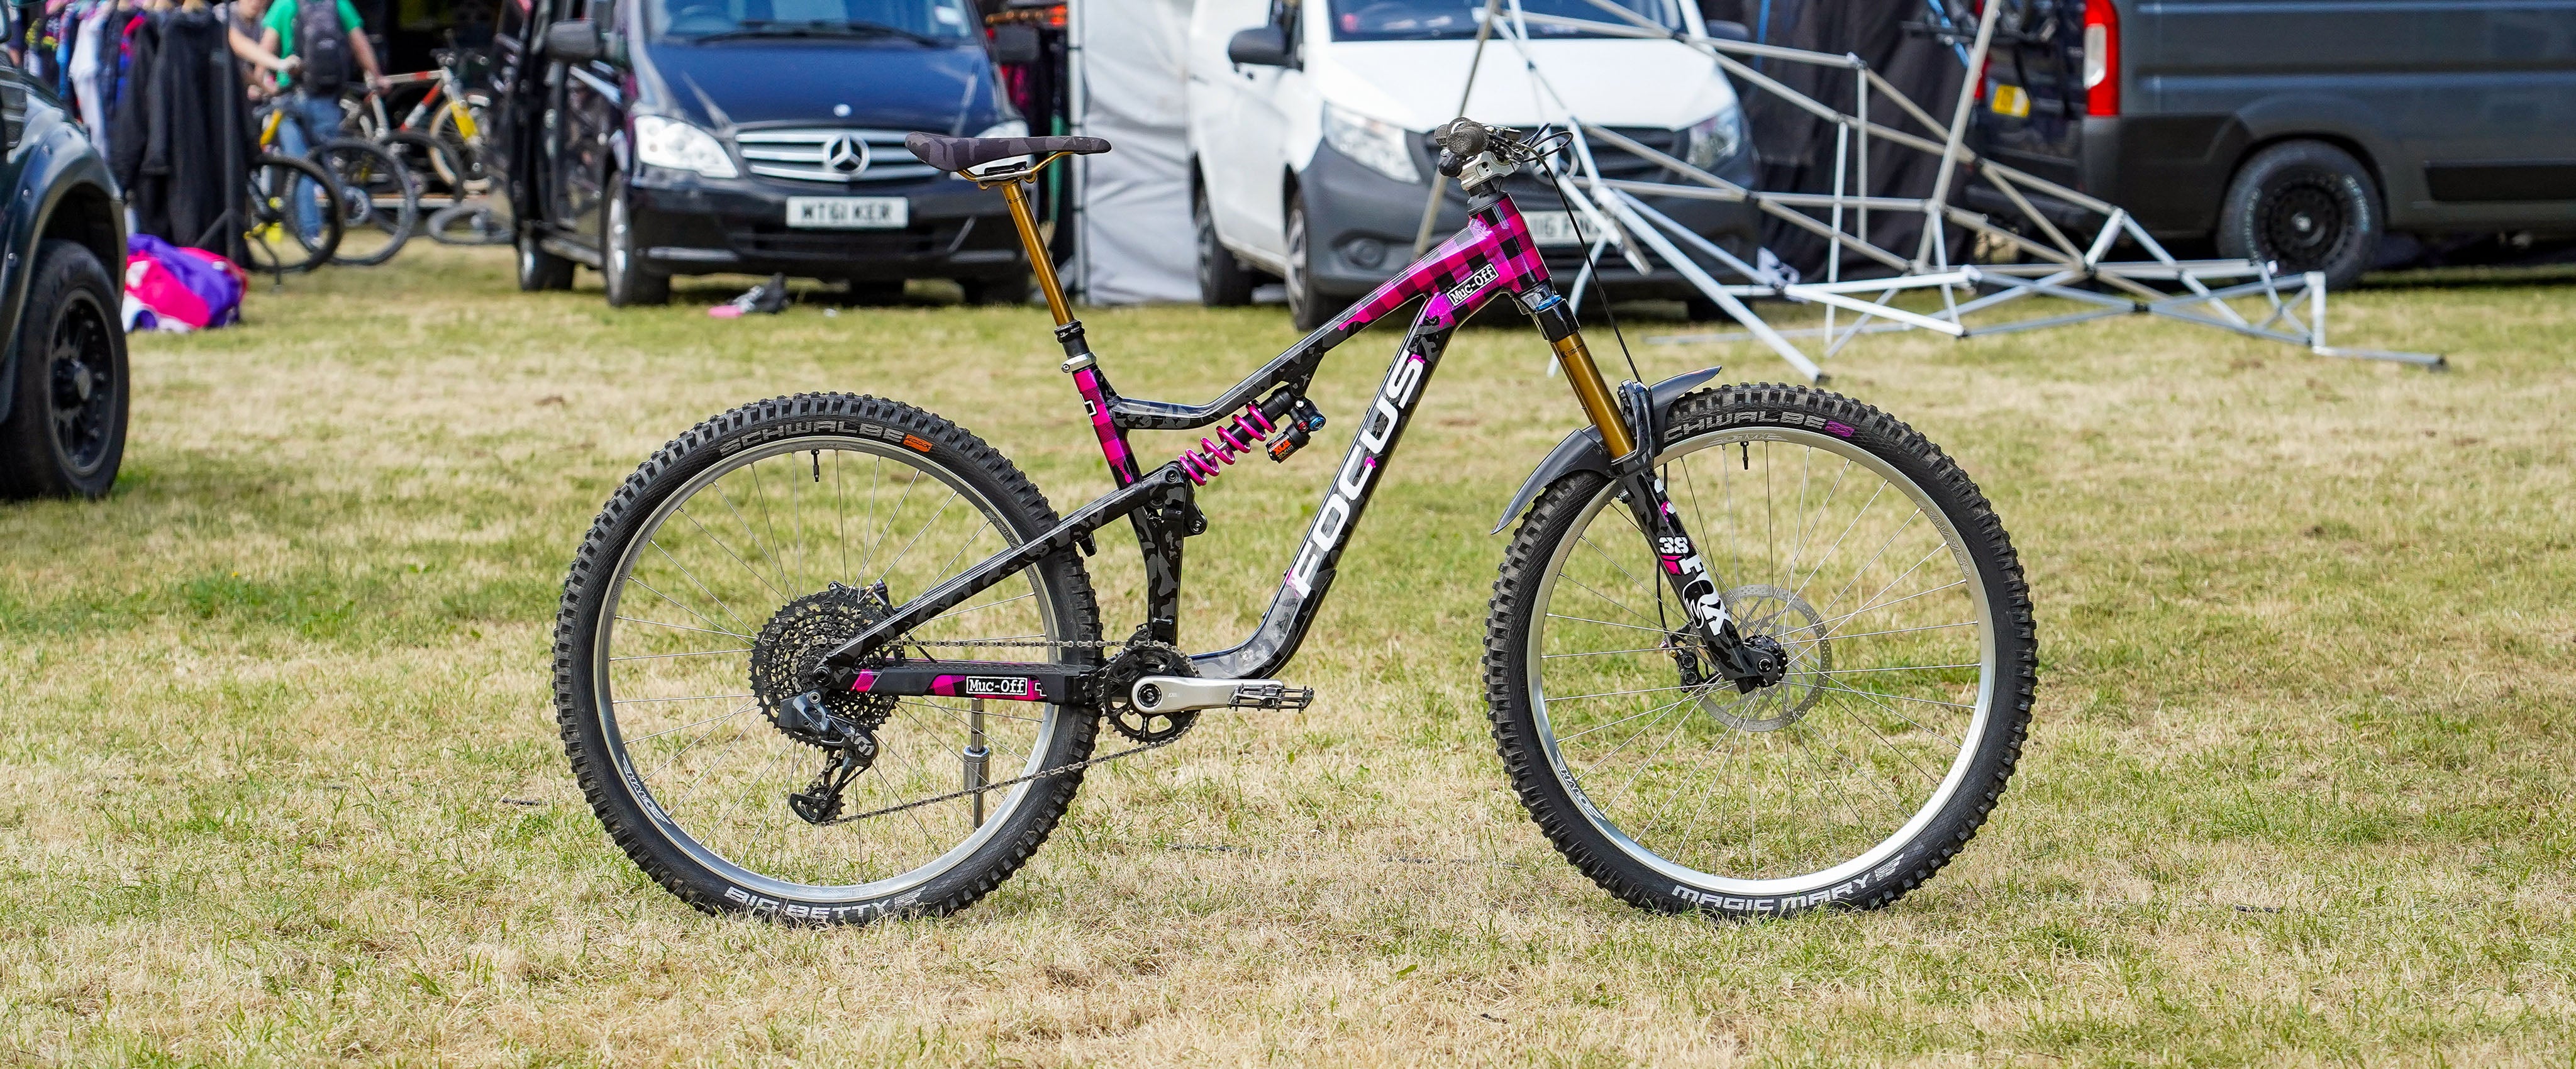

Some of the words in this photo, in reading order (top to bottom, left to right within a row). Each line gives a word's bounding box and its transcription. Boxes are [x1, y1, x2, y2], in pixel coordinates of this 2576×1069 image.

[1450, 265, 1496, 303] Muc-Off
[719, 421, 904, 456] SCHWALBE
[1664, 411, 1826, 443] CHWALBE
[1272, 439, 1292, 456] FOX
[1286, 349, 1425, 599] FOCUS
[1915, 497, 1972, 576] GRAVITAS
[1678, 553, 1733, 636] FOX
[969, 679, 1025, 693] Muc-Off
[724, 886, 780, 912] BIG
[787, 899, 890, 919] BETTY
[1672, 884, 1774, 911] MAGIC
[1780, 873, 1870, 909] MARY
